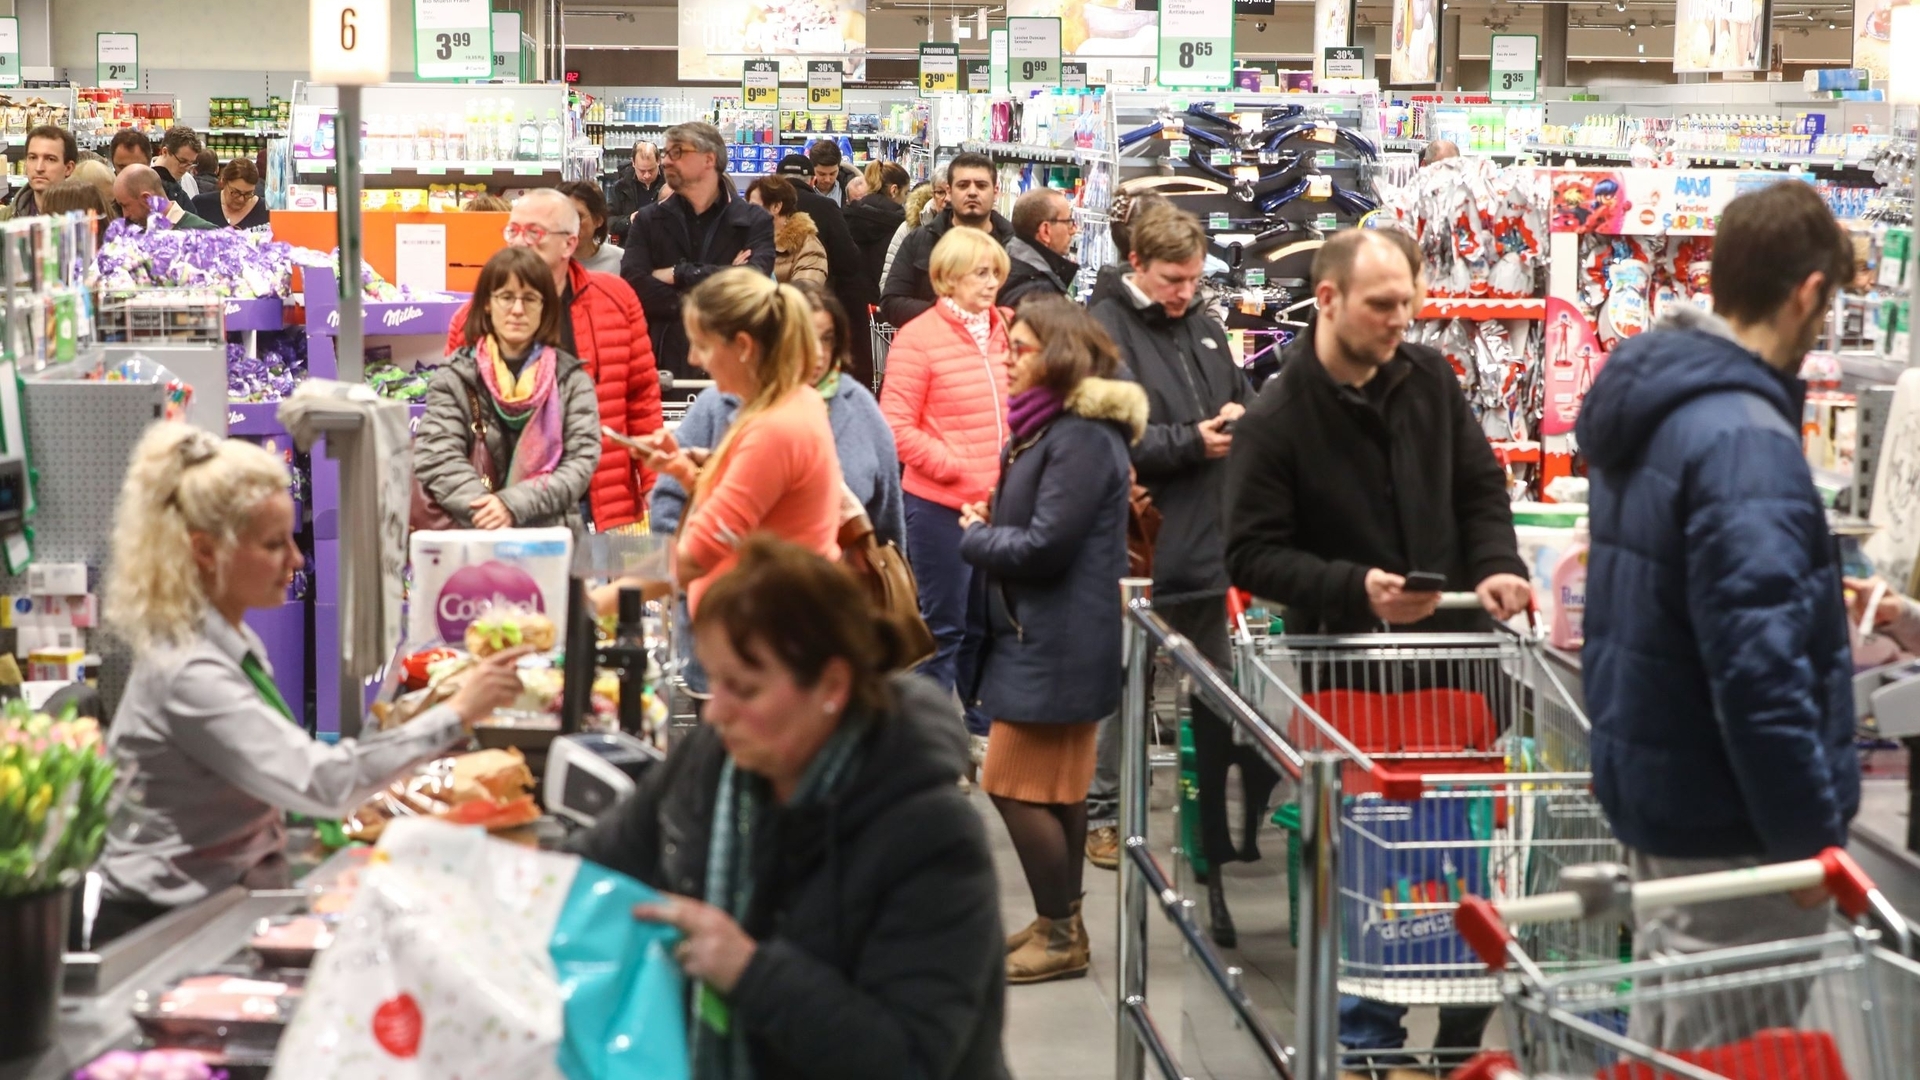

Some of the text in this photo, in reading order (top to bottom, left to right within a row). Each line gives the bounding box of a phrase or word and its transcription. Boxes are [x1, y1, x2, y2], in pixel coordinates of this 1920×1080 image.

[341, 8, 356, 50] 6
[1334, 50, 1355, 60] -30%
[752, 62, 772, 72] -40%
[815, 63, 835, 72] -30%
[1062, 65, 1079, 74] 60%
[566, 73, 578, 81] 82
[1674, 176, 1711, 197] MAXI
[1676, 203, 1709, 212] kinder
[383, 306, 424, 327] Milka
